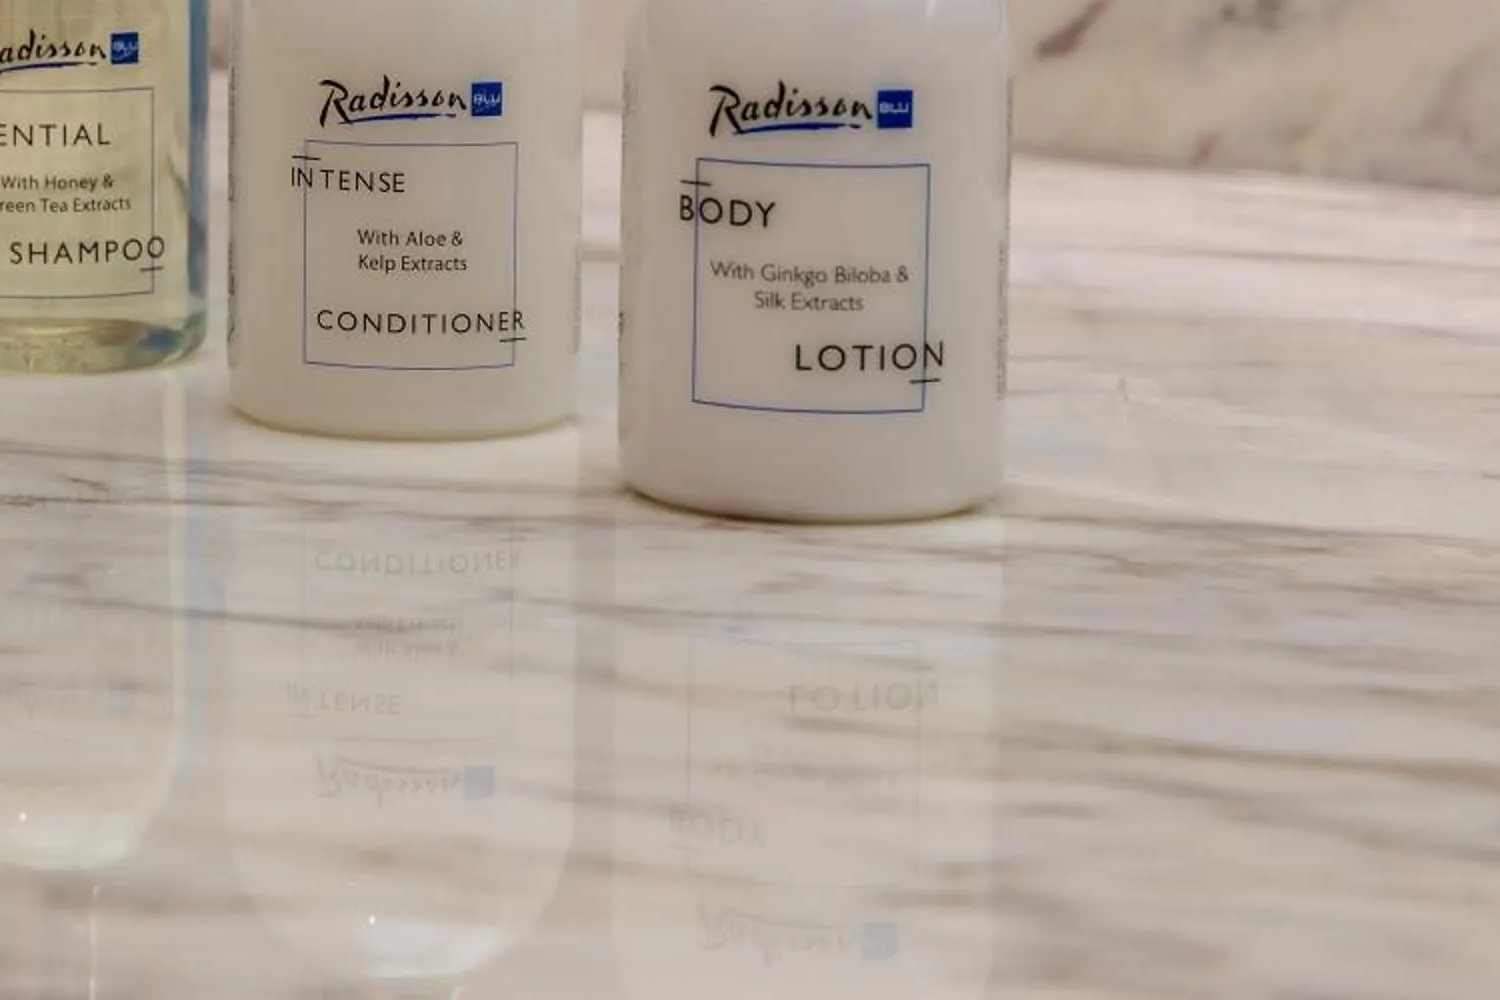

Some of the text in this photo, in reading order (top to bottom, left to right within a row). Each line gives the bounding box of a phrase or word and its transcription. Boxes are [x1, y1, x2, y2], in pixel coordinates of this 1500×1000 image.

[319, 74, 467, 128] Radisson
[708, 81, 873, 137] Radisson
[1, 173, 115, 193] With Honey &
[291, 167, 405, 193] INTENSE
[42, 199, 68, 213] Tea
[73, 197, 132, 214] Extracts
[680, 194, 776, 228] BODY
[9, 236, 165, 265] SHAMPOO
[357, 229, 463, 247] With Aloe &
[358, 253, 468, 274] Kelp Extracts
[710, 260, 909, 288] With Ginkgo Biloba &
[755, 290, 864, 312] Silk Extracts
[316, 308, 525, 334] CONDITIONER
[796, 340, 944, 372] LOTION
